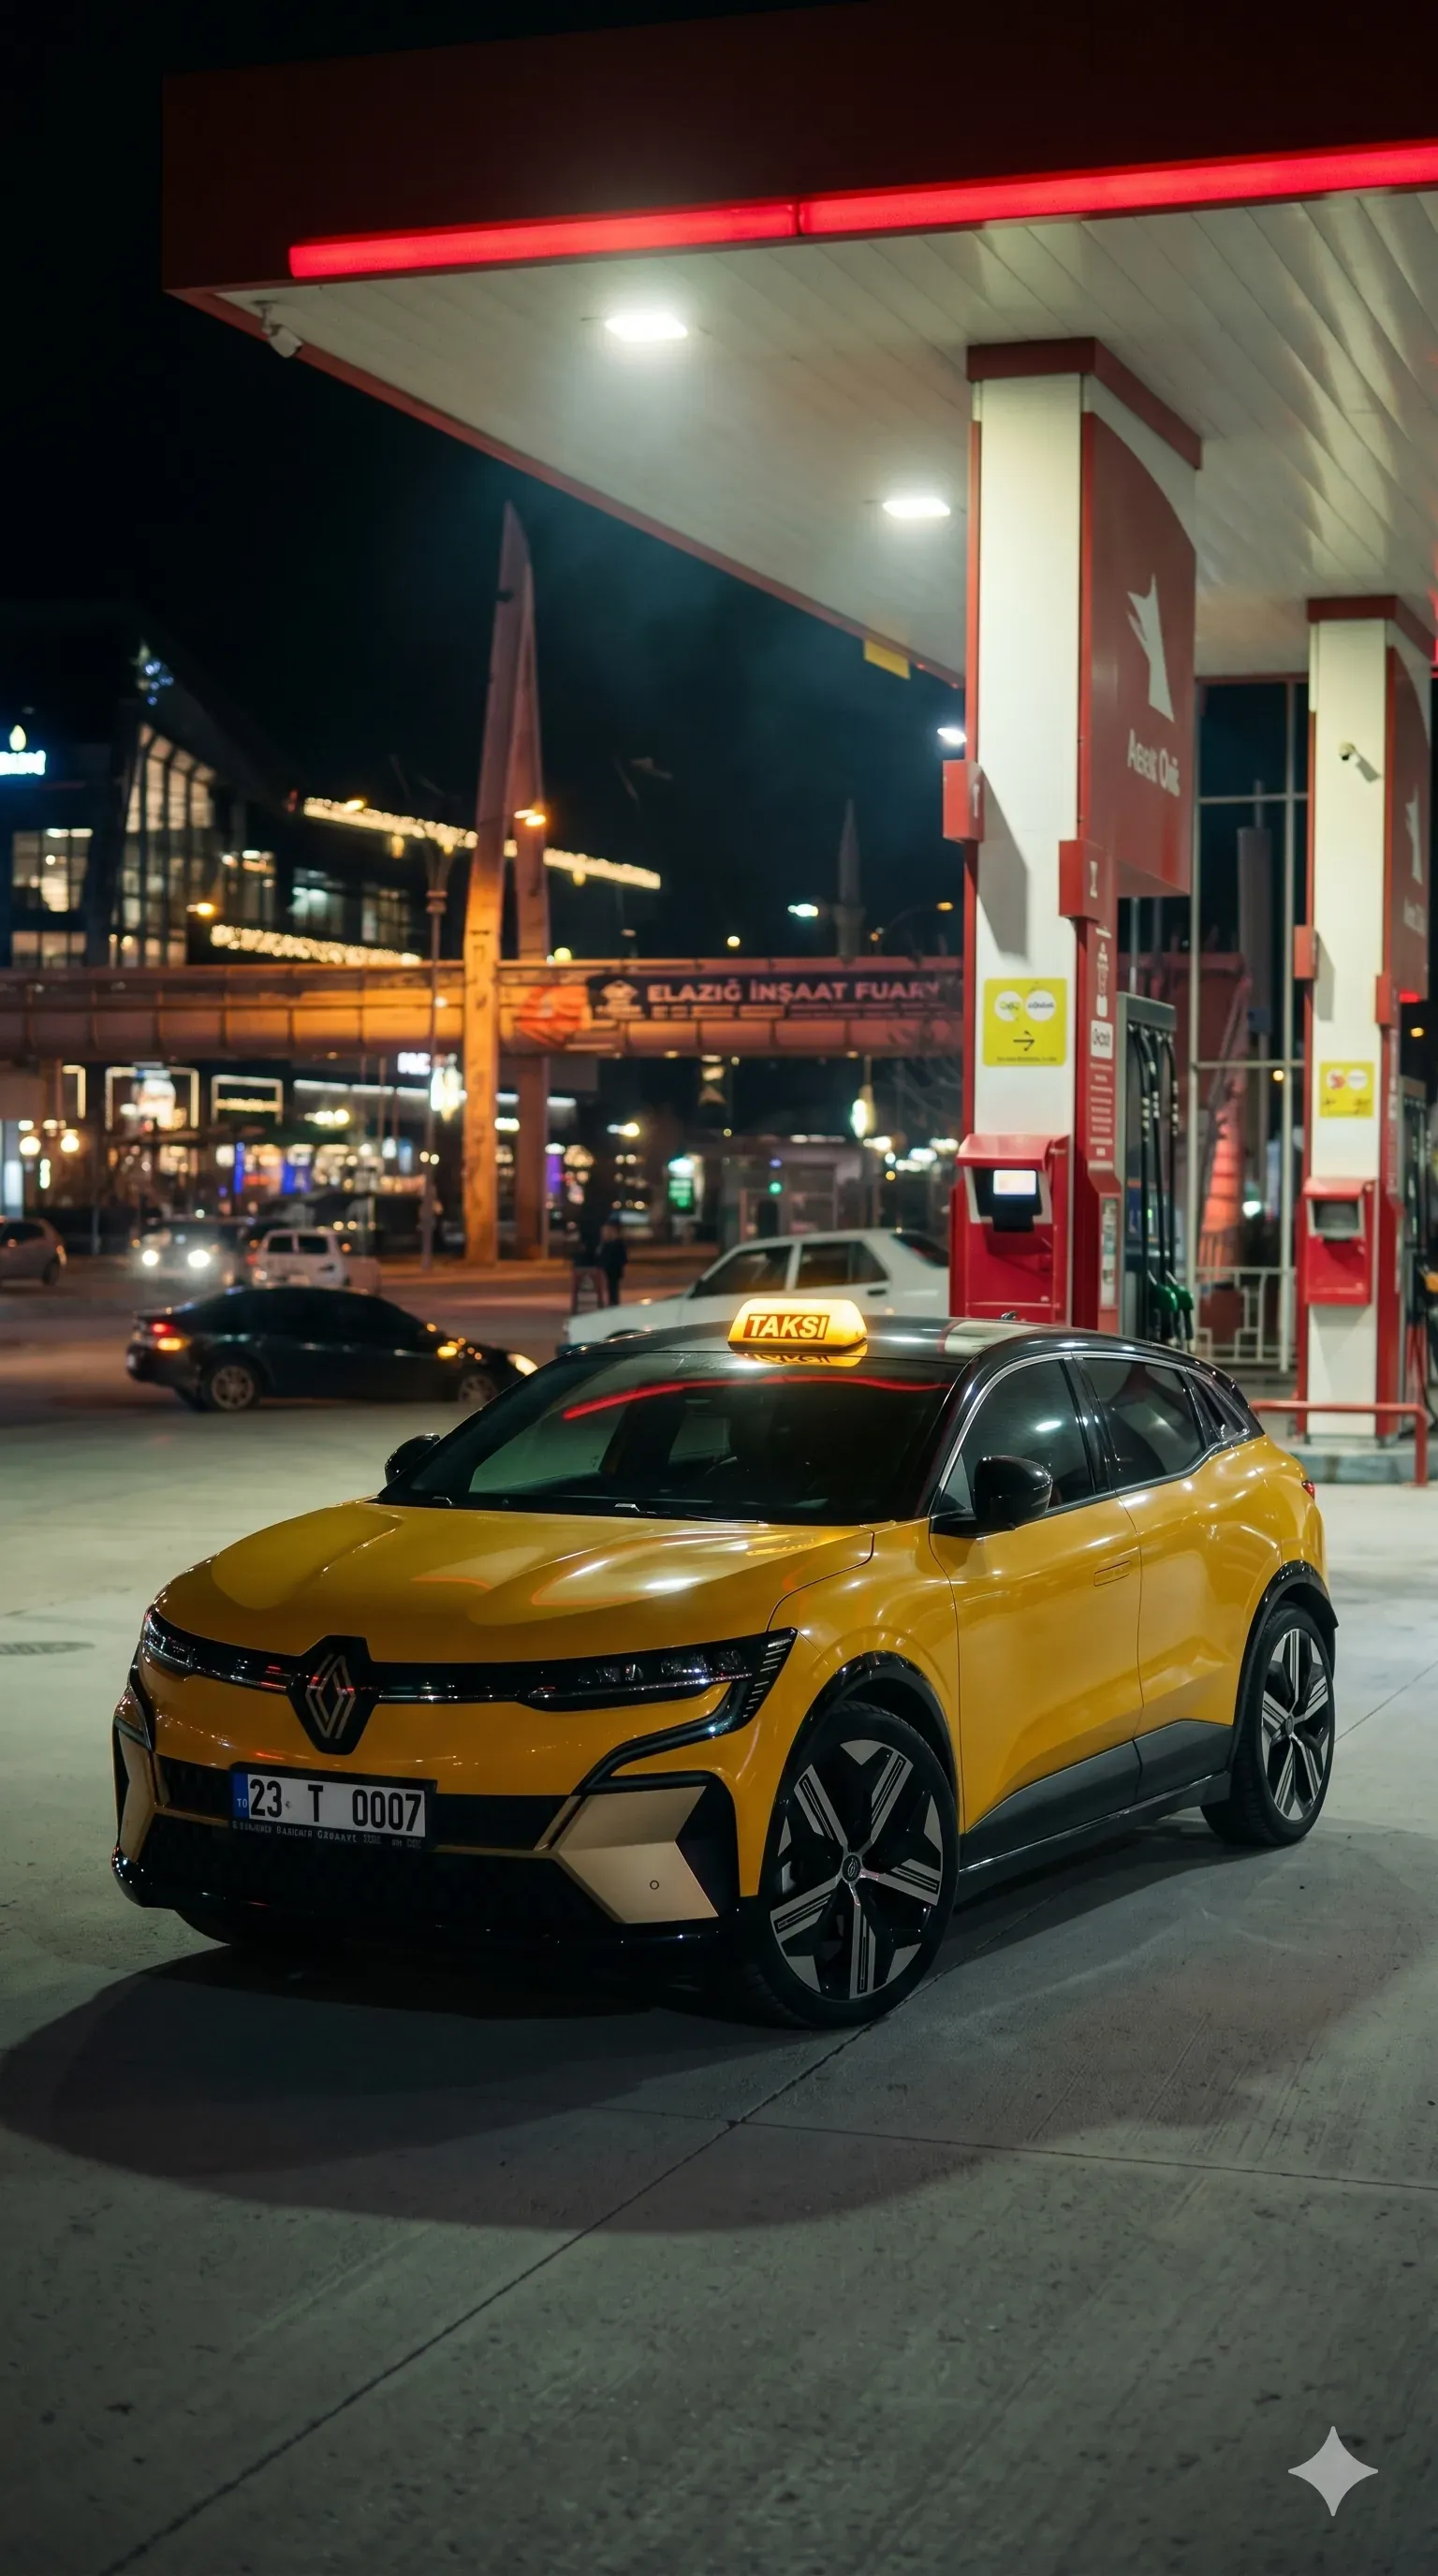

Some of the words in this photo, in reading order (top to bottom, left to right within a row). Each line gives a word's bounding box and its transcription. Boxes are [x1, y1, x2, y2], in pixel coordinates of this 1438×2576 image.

[647, 978, 741, 1003] ELAZIĞ
[750, 978, 848, 1004] İNŞAAT
[749, 1315, 828, 1339] TAKSI
[249, 1778, 283, 1818] 23
[308, 1784, 324, 1822] T
[352, 1789, 421, 1832] 0007
